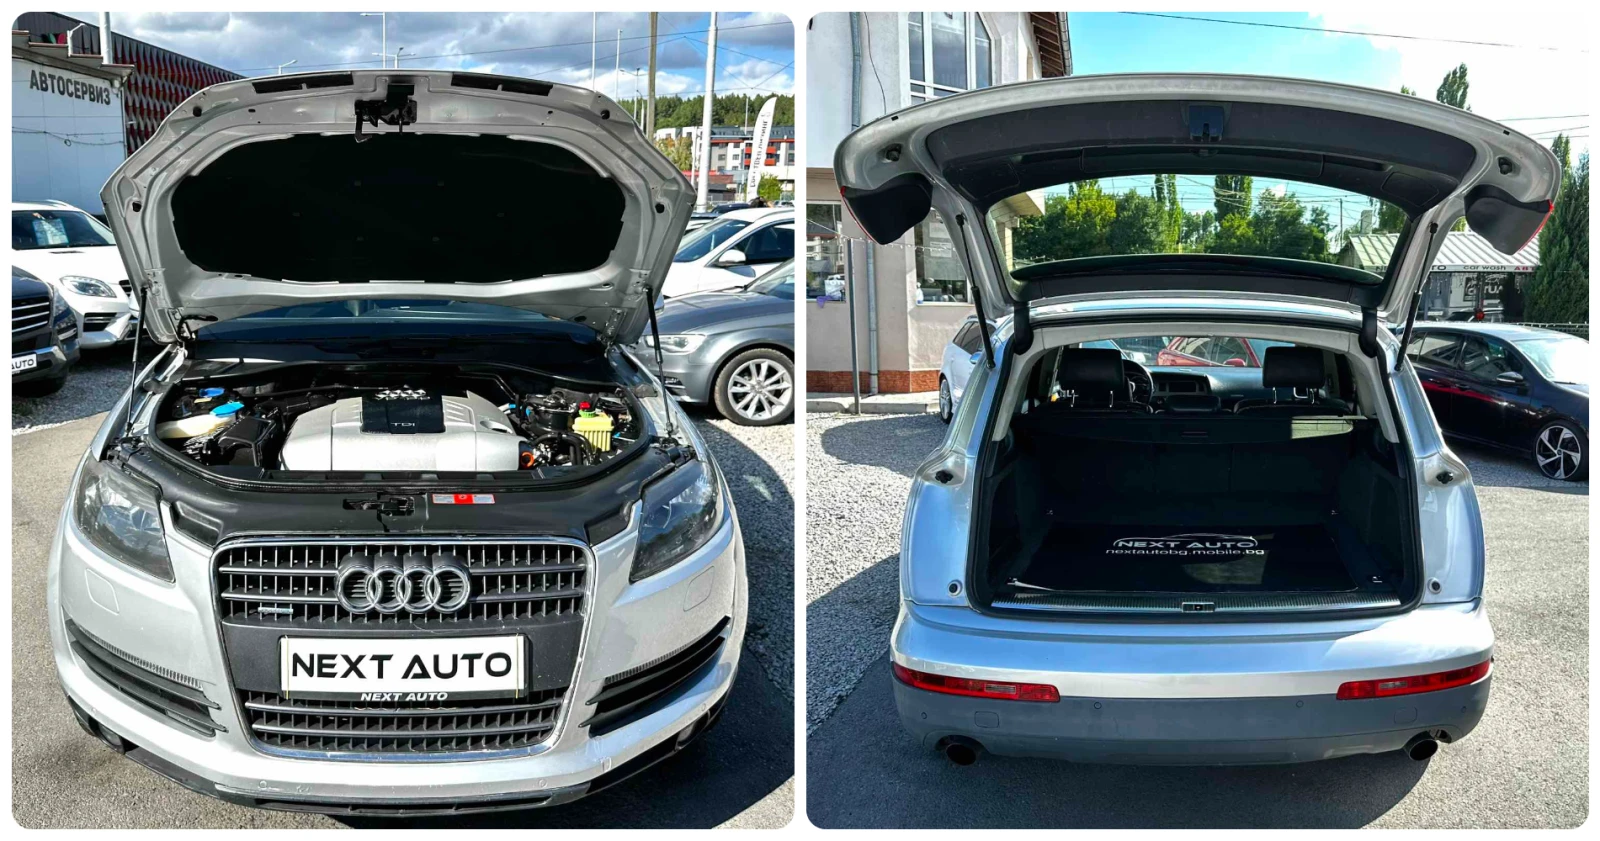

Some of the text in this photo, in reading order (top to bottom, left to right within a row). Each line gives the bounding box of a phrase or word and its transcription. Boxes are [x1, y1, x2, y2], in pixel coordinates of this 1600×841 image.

[29, 69, 111, 105] АВТОСЕРВИЗ
[291, 652, 513, 680] NEXT AUTO
[360, 692, 449, 701] NEXT AUTO
